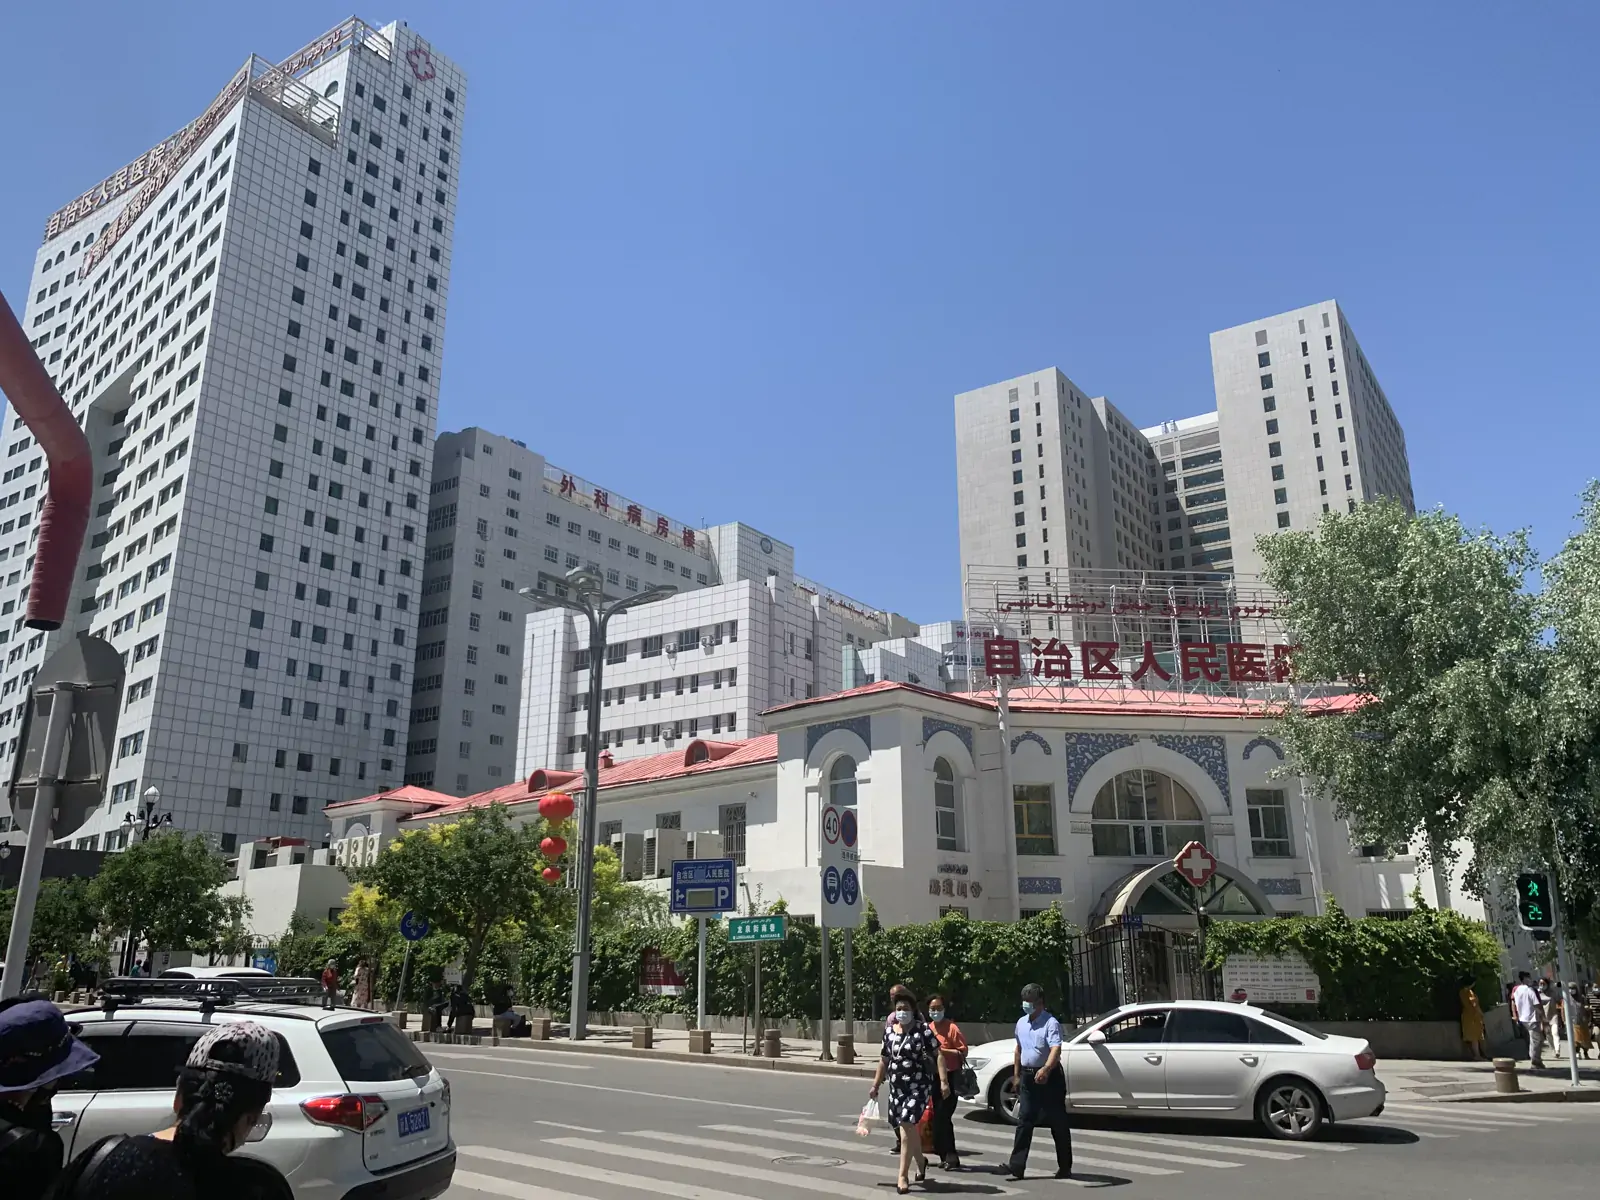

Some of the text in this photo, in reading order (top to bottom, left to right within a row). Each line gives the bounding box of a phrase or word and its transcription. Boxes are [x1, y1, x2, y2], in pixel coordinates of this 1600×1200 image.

[47, 143, 167, 239] 自治区人民医院
[560, 473, 696, 549] 外科病房楼
[826, 817, 838, 835] 40
[717, 886, 729, 907] P
